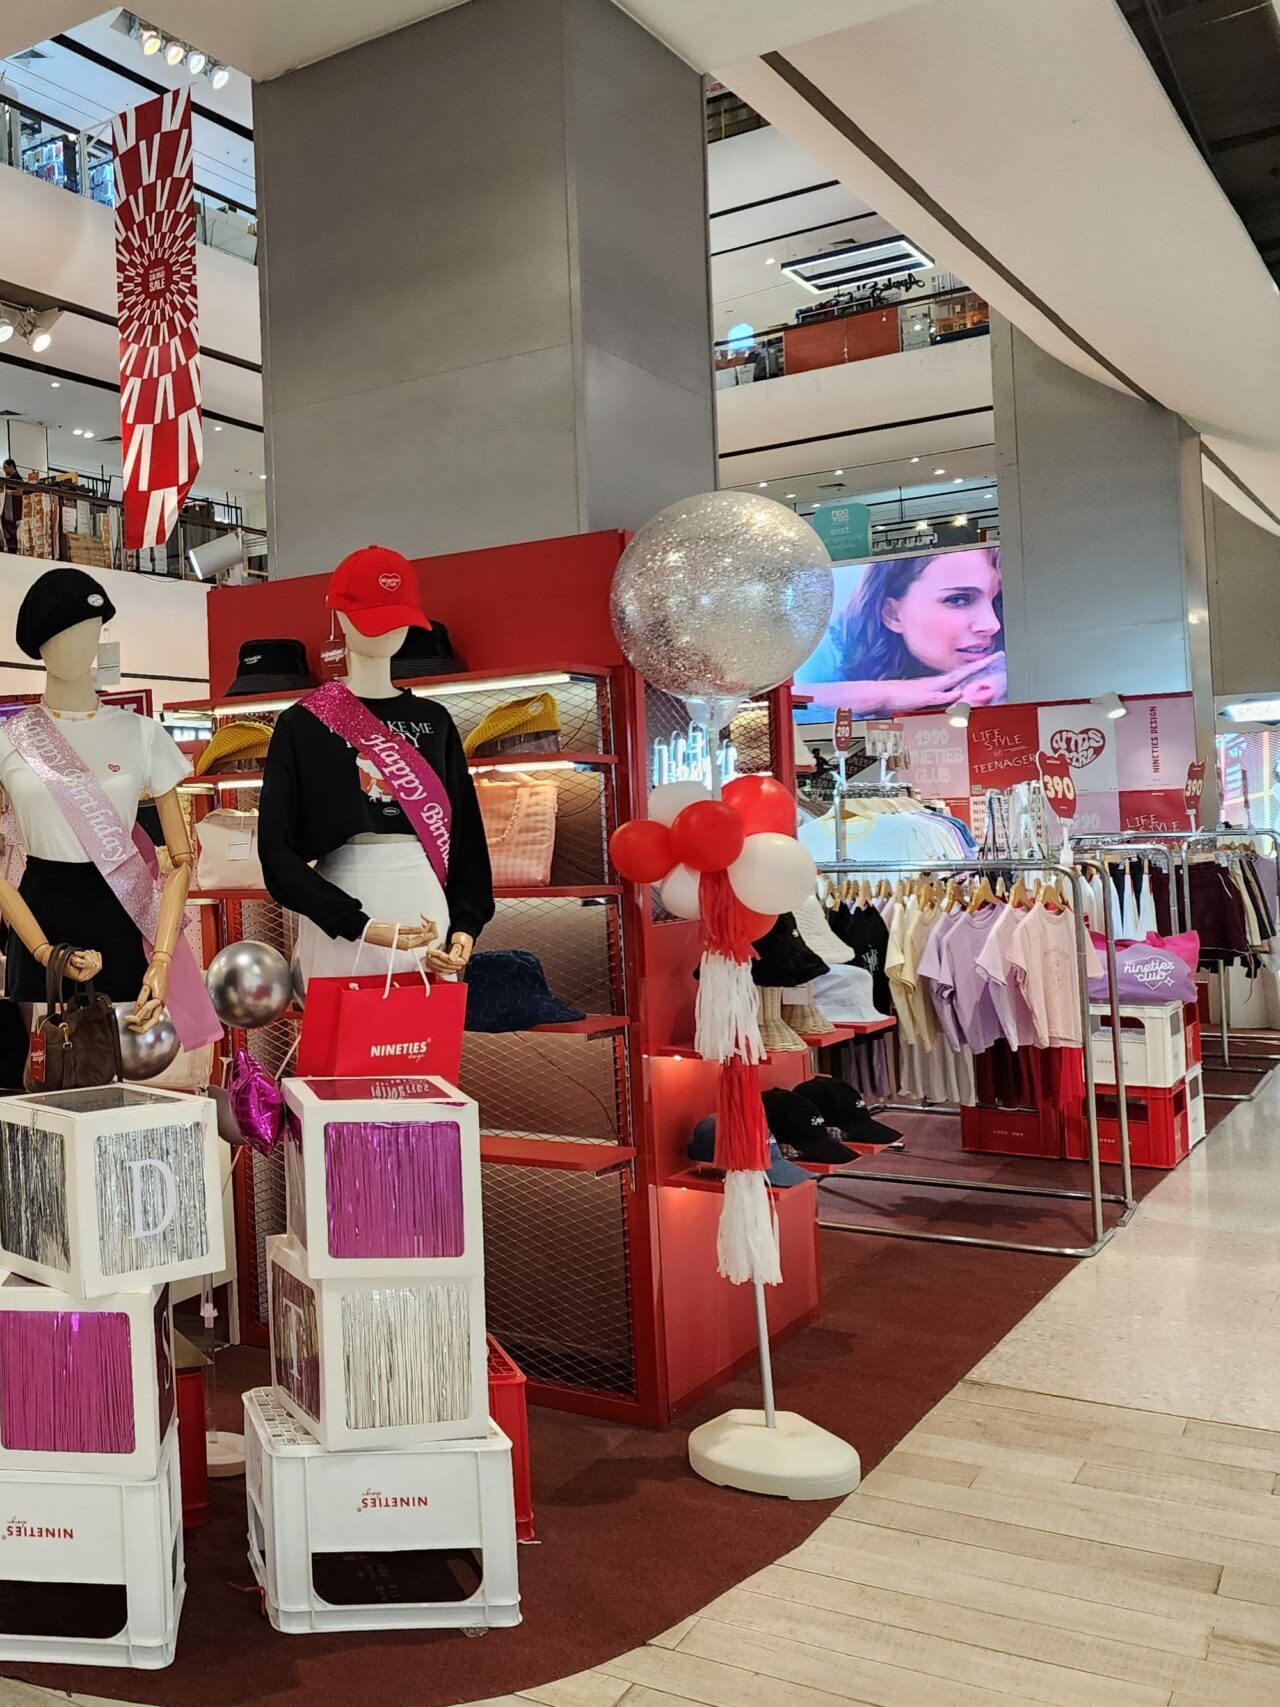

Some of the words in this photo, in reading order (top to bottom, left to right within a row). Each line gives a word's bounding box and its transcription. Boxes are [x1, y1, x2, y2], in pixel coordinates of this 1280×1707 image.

[149, 278, 166, 292] SALE
[410, 721, 434, 734] ME
[1149, 706, 1158, 734] DESIGN
[916, 728, 949, 746] 1990
[972, 728, 1002, 742] LIFE
[984, 734, 1022, 751] STYLE
[972, 753, 1037, 774] TEENAGER
[1151, 737, 1160, 773] NINETIES
[360, 734, 427, 800] Happy
[20, 710, 66, 767] Happy
[63, 768, 127, 862] Birthday
[1044, 774, 1074, 800] 390
[1185, 779, 1203, 797] 390
[1126, 814, 1158, 828] LIFE
[1124, 960, 1175, 974] nineties
[1137, 969, 1168, 982] club
[370, 1041, 427, 1058] NINETIES
[125, 1159, 176, 1239] D
[282, 1297, 305, 1381] T
[361, 1496, 428, 1509] NINETIES
[6, 1525, 74, 1540] NINETIES
